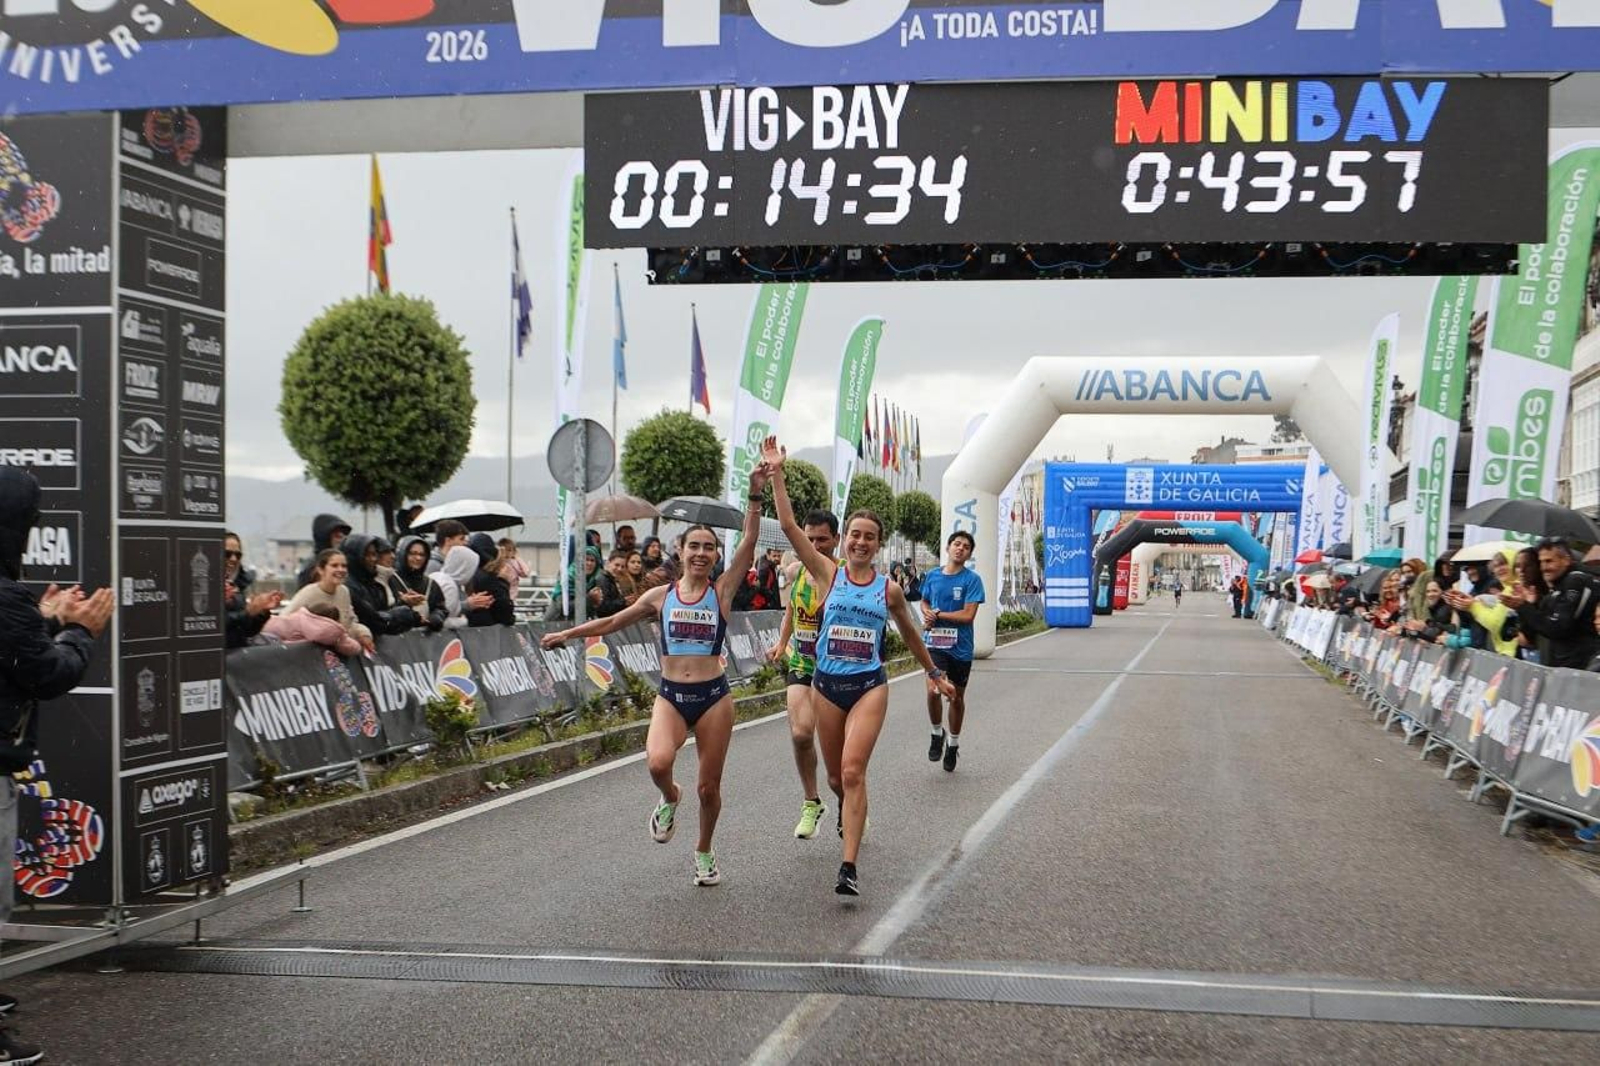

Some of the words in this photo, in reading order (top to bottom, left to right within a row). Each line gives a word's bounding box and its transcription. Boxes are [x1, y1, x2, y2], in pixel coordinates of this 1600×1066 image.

[0, 0, 176, 83] NIVERS
[900, 14, 926, 47] ¡A
[933, 12, 999, 39] TODA
[1008, 9, 1097, 36] COSTA!
[426, 30, 489, 62] 2026
[700, 87, 779, 151] VIG
[812, 85, 910, 150] BAY
[1115, 81, 1447, 144] MINIBAY
[1121, 151, 1423, 214] 0:43:57
[1545, 168, 1588, 305] colaboración
[0, 250, 20, 278] a,
[24, 247, 46, 274] la
[50, 245, 110, 274] mitad
[1518, 286, 1536, 305] El
[755, 341, 768, 358] El
[762, 290, 781, 340] poder
[1437, 300, 1451, 351] poder
[1537, 310, 1556, 327] la
[1534, 332, 1552, 359] de
[761, 380, 774, 401] de
[1095, 369, 1272, 402] ABANCA
[1160, 471, 1223, 486] XUNTA
[1160, 488, 1182, 501] DE
[1188, 488, 1261, 502] GALICIA
[1154, 528, 1216, 536] POWERADE
[672, 610, 713, 621] MINIBAY
[831, 629, 872, 639] MINIBAY
[238, 683, 335, 743] MINIBAY
